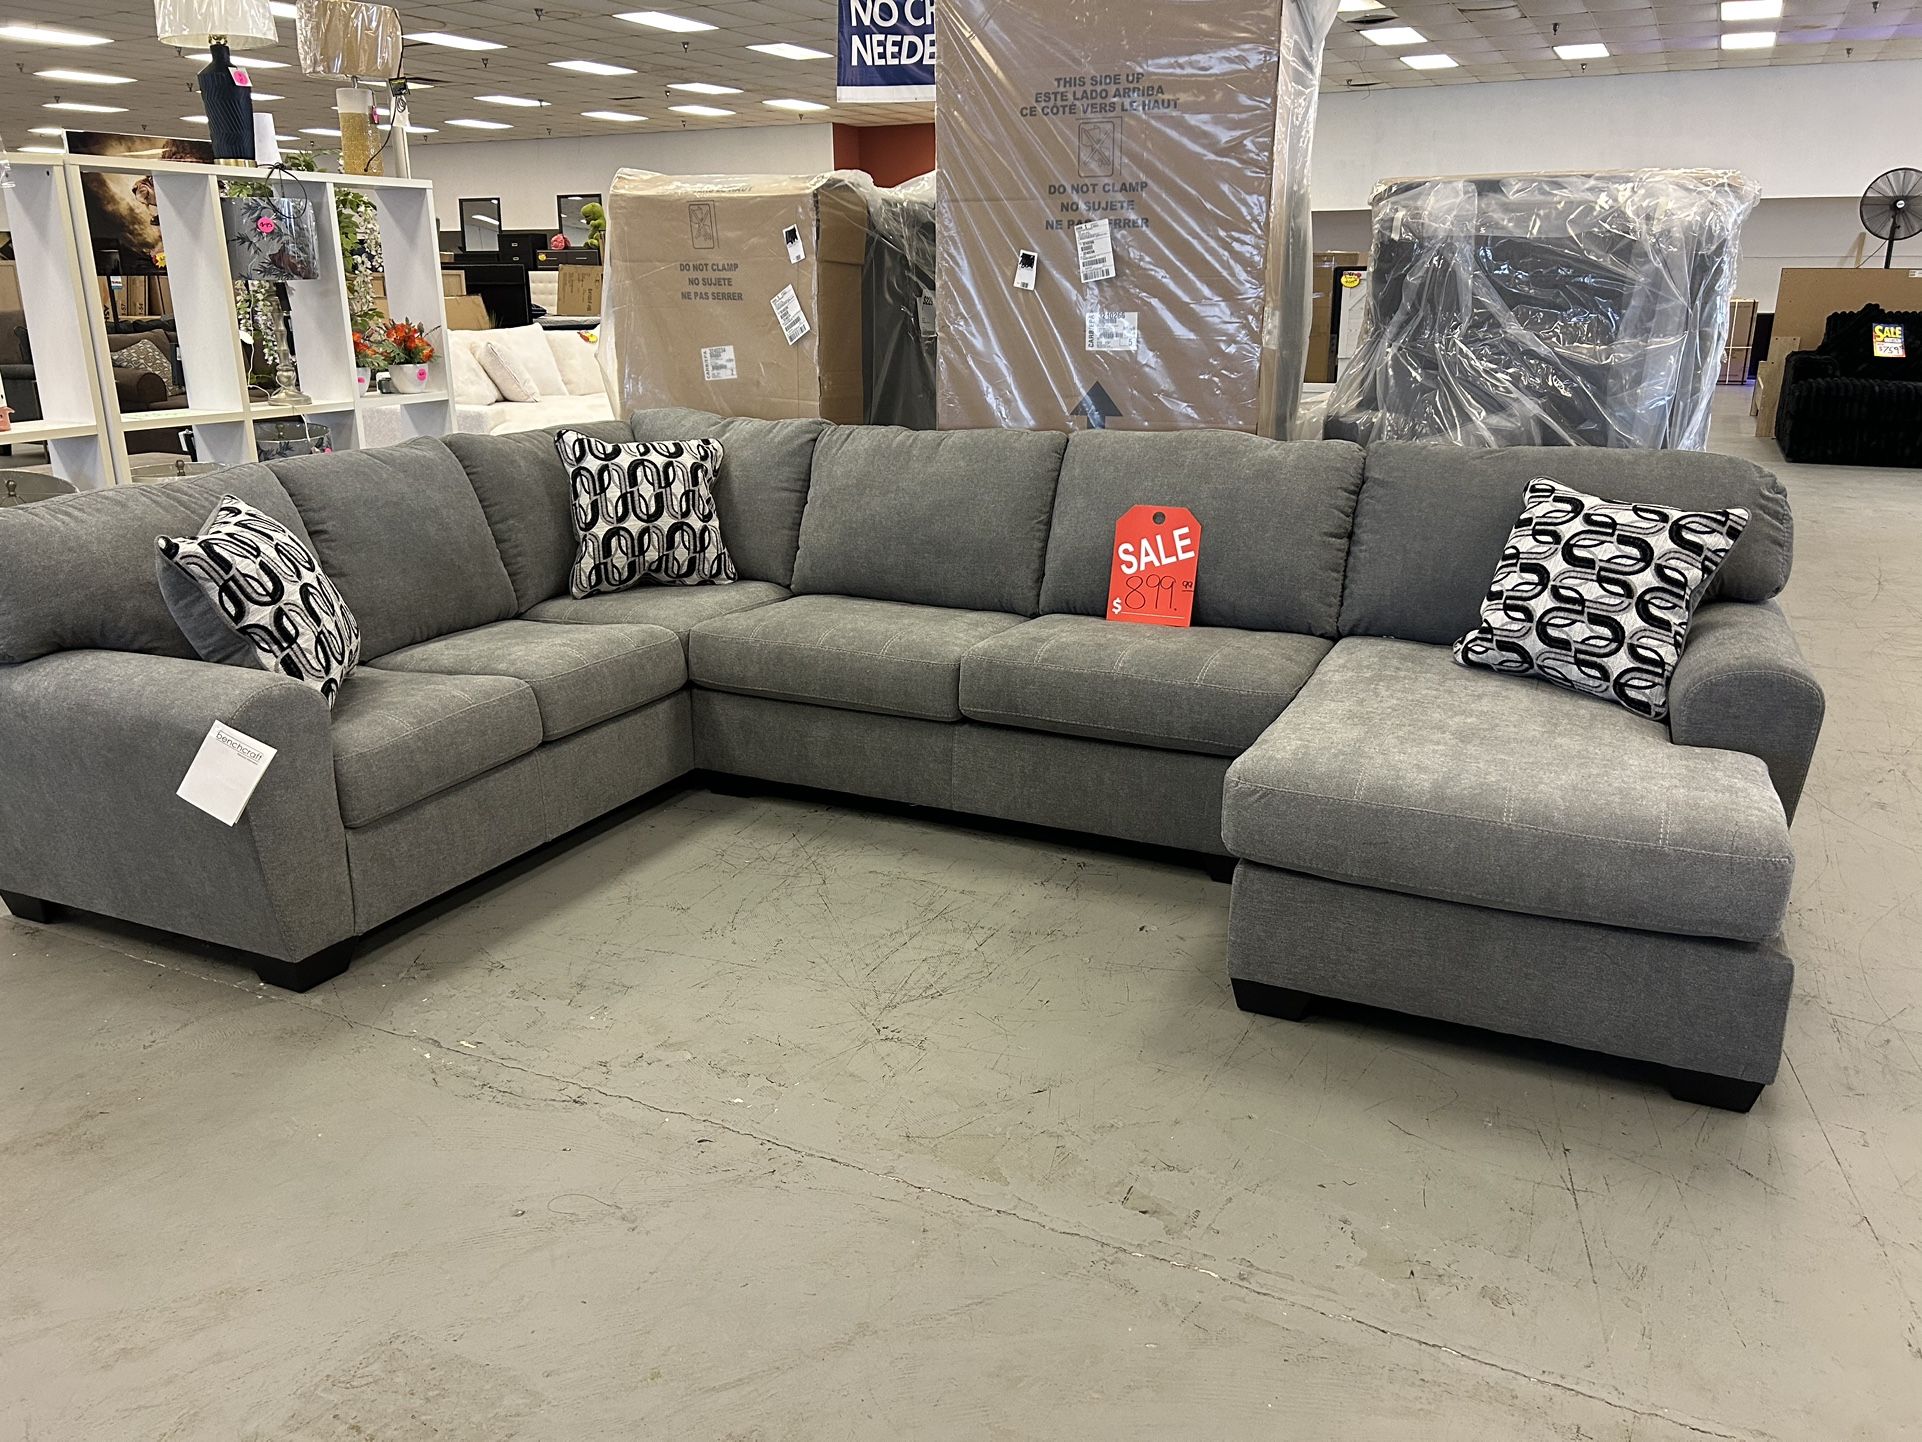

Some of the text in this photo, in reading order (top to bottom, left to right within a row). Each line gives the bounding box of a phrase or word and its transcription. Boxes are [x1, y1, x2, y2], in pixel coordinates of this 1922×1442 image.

[850, 0, 898, 27] NO
[1055, 72, 1145, 88] THIS SIDE UP
[1035, 85, 1165, 103] ESTE LADO ARRIBA
[1020, 98, 1180, 117] CE CÔTÉ VERS LE HAUT
[1048, 181, 1148, 195] DO NOT CLAMP
[1060, 200, 1135, 212] NO SUJETE
[1046, 220, 1063, 230] NE
[1107, 217, 1149, 229] ERRER
[680, 263, 739, 272] DO NOT CLAMP
[688, 277, 733, 286] NO SUJETE
[681, 291, 743, 301] NE PAS SERRER
[1874, 325, 1902, 341] SALE
[1118, 527, 1195, 574] SALE
[216, 731, 262, 761] benchcraft
